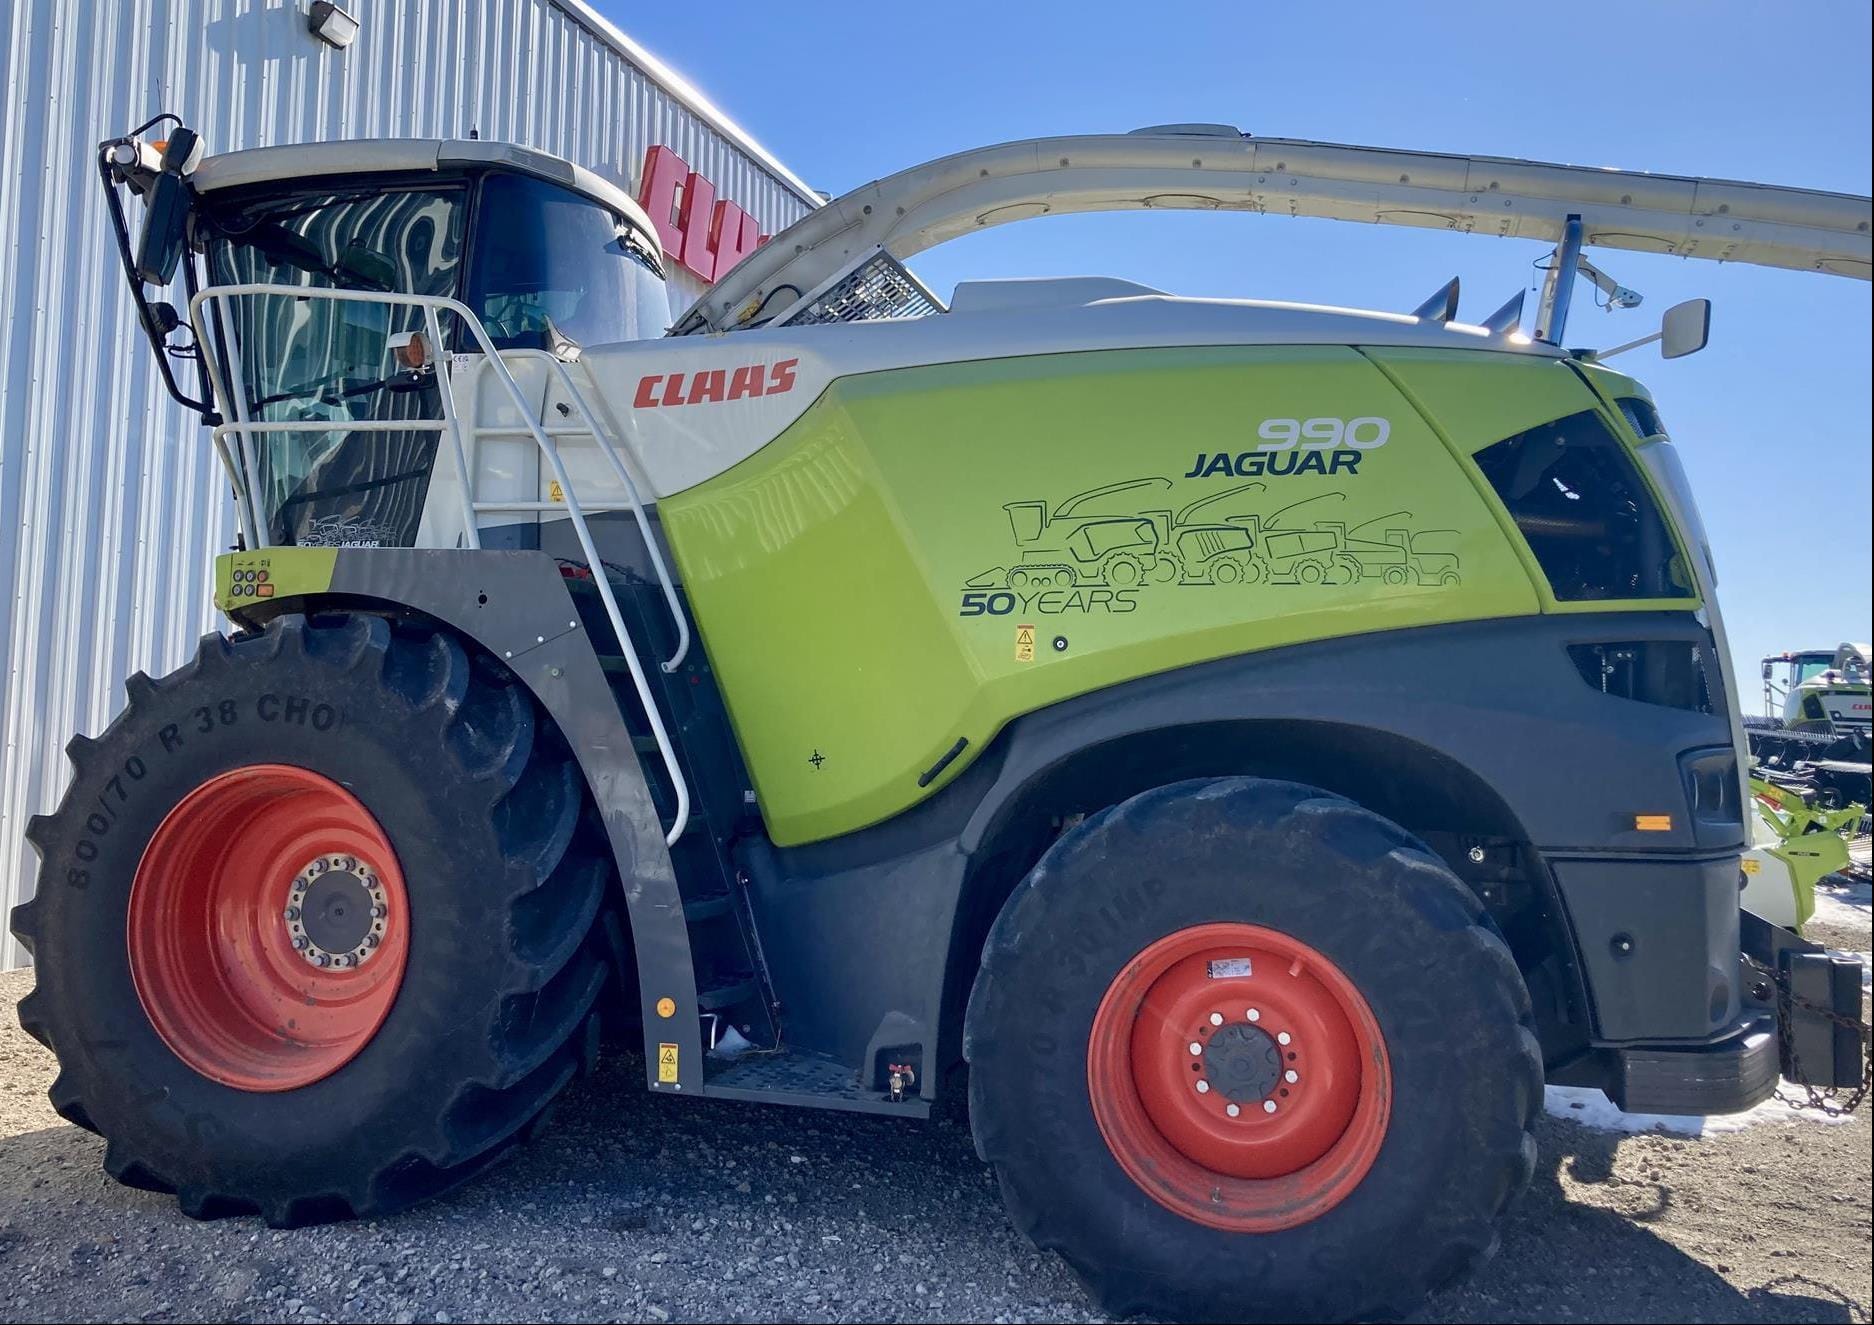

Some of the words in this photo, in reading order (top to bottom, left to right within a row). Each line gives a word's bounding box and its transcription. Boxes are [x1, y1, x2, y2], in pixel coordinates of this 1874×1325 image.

[633, 358, 798, 408] CLAAS
[1257, 416, 1391, 451] 990
[1184, 450, 1362, 478] JAGUAR
[341, 540, 379, 549] JAGUAR
[67, 755, 147, 890] 800/70
[157, 722, 185, 754] R
[194, 699, 238, 734] 38
